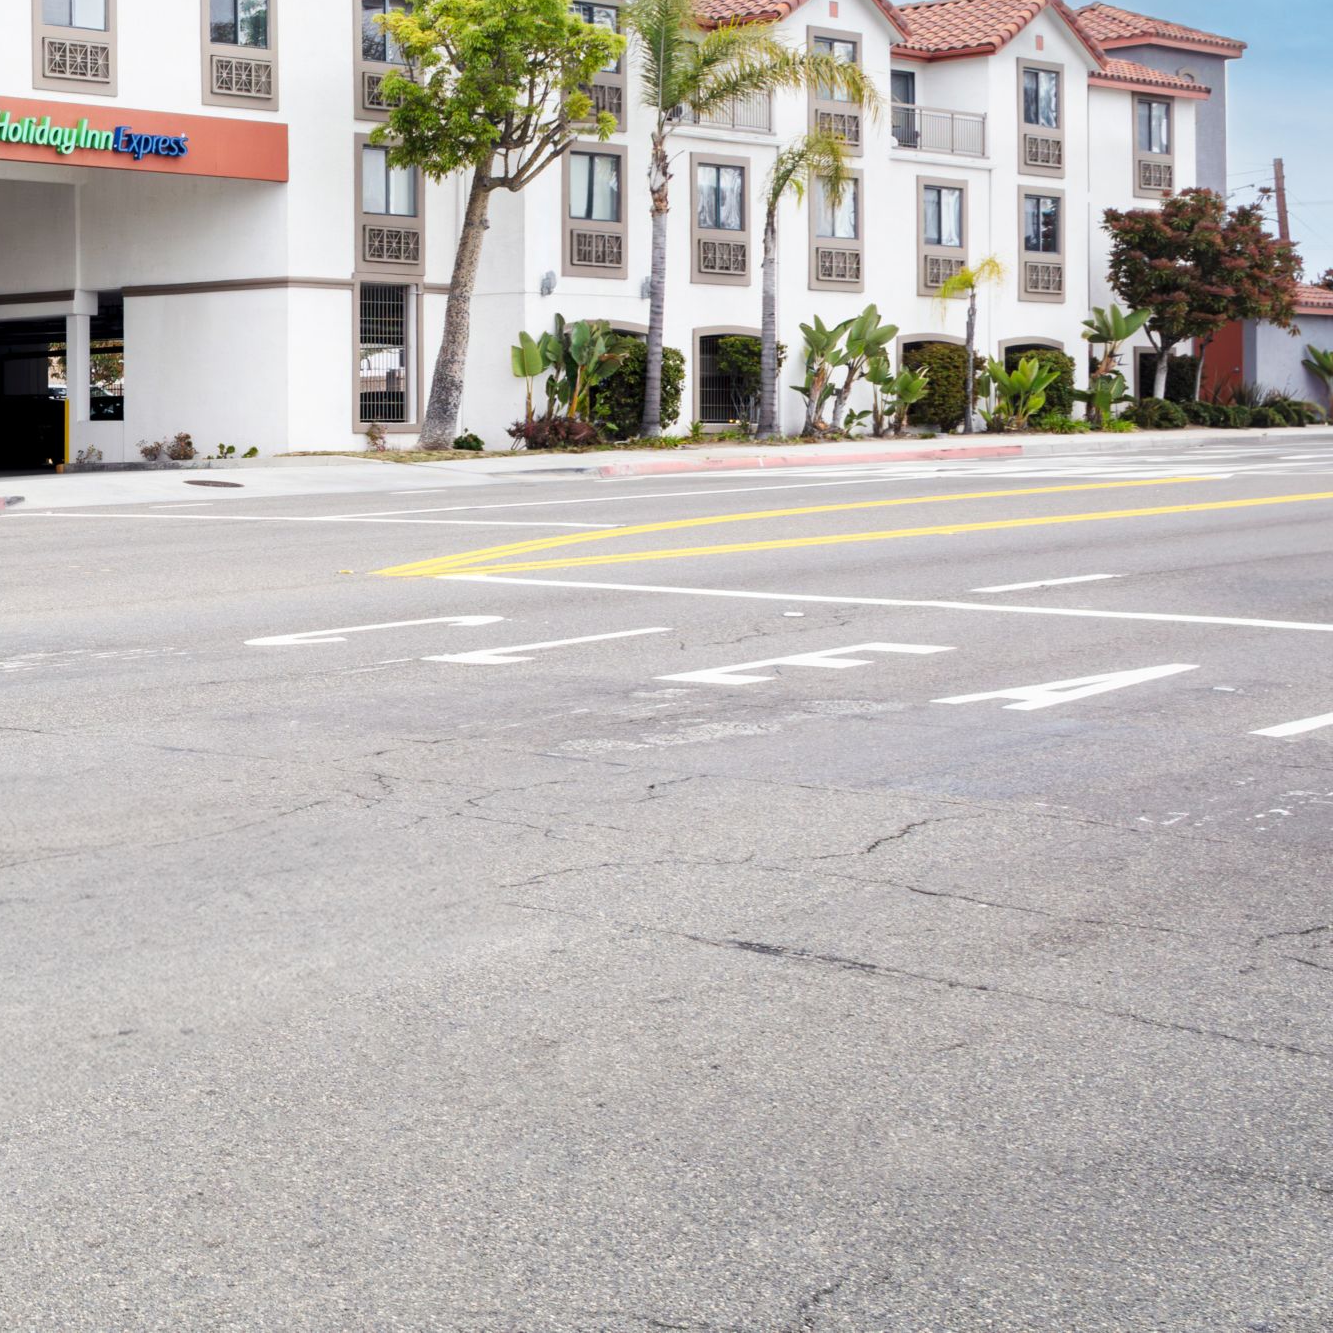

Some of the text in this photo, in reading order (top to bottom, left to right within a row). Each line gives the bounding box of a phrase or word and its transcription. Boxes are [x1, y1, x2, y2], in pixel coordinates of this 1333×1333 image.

[76, 118, 114, 151] Inn
[114, 126, 189, 161] Express
[244, 615, 1333, 737] CLEA
